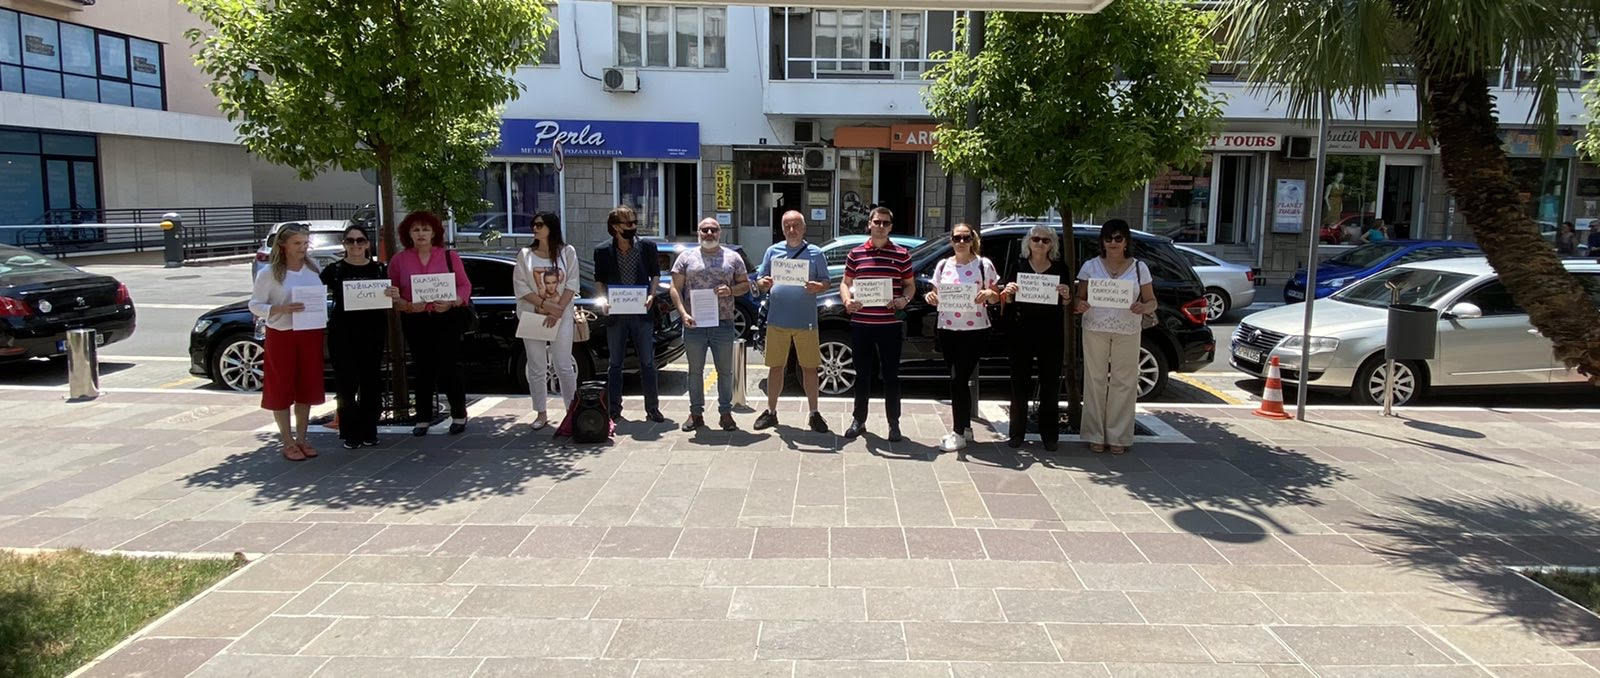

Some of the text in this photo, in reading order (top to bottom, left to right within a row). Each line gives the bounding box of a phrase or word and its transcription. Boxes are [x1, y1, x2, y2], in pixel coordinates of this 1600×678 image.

[534, 120, 606, 146] Perla
[1224, 136, 1276, 147] TOURS
[1359, 130, 1432, 150] NIVA
